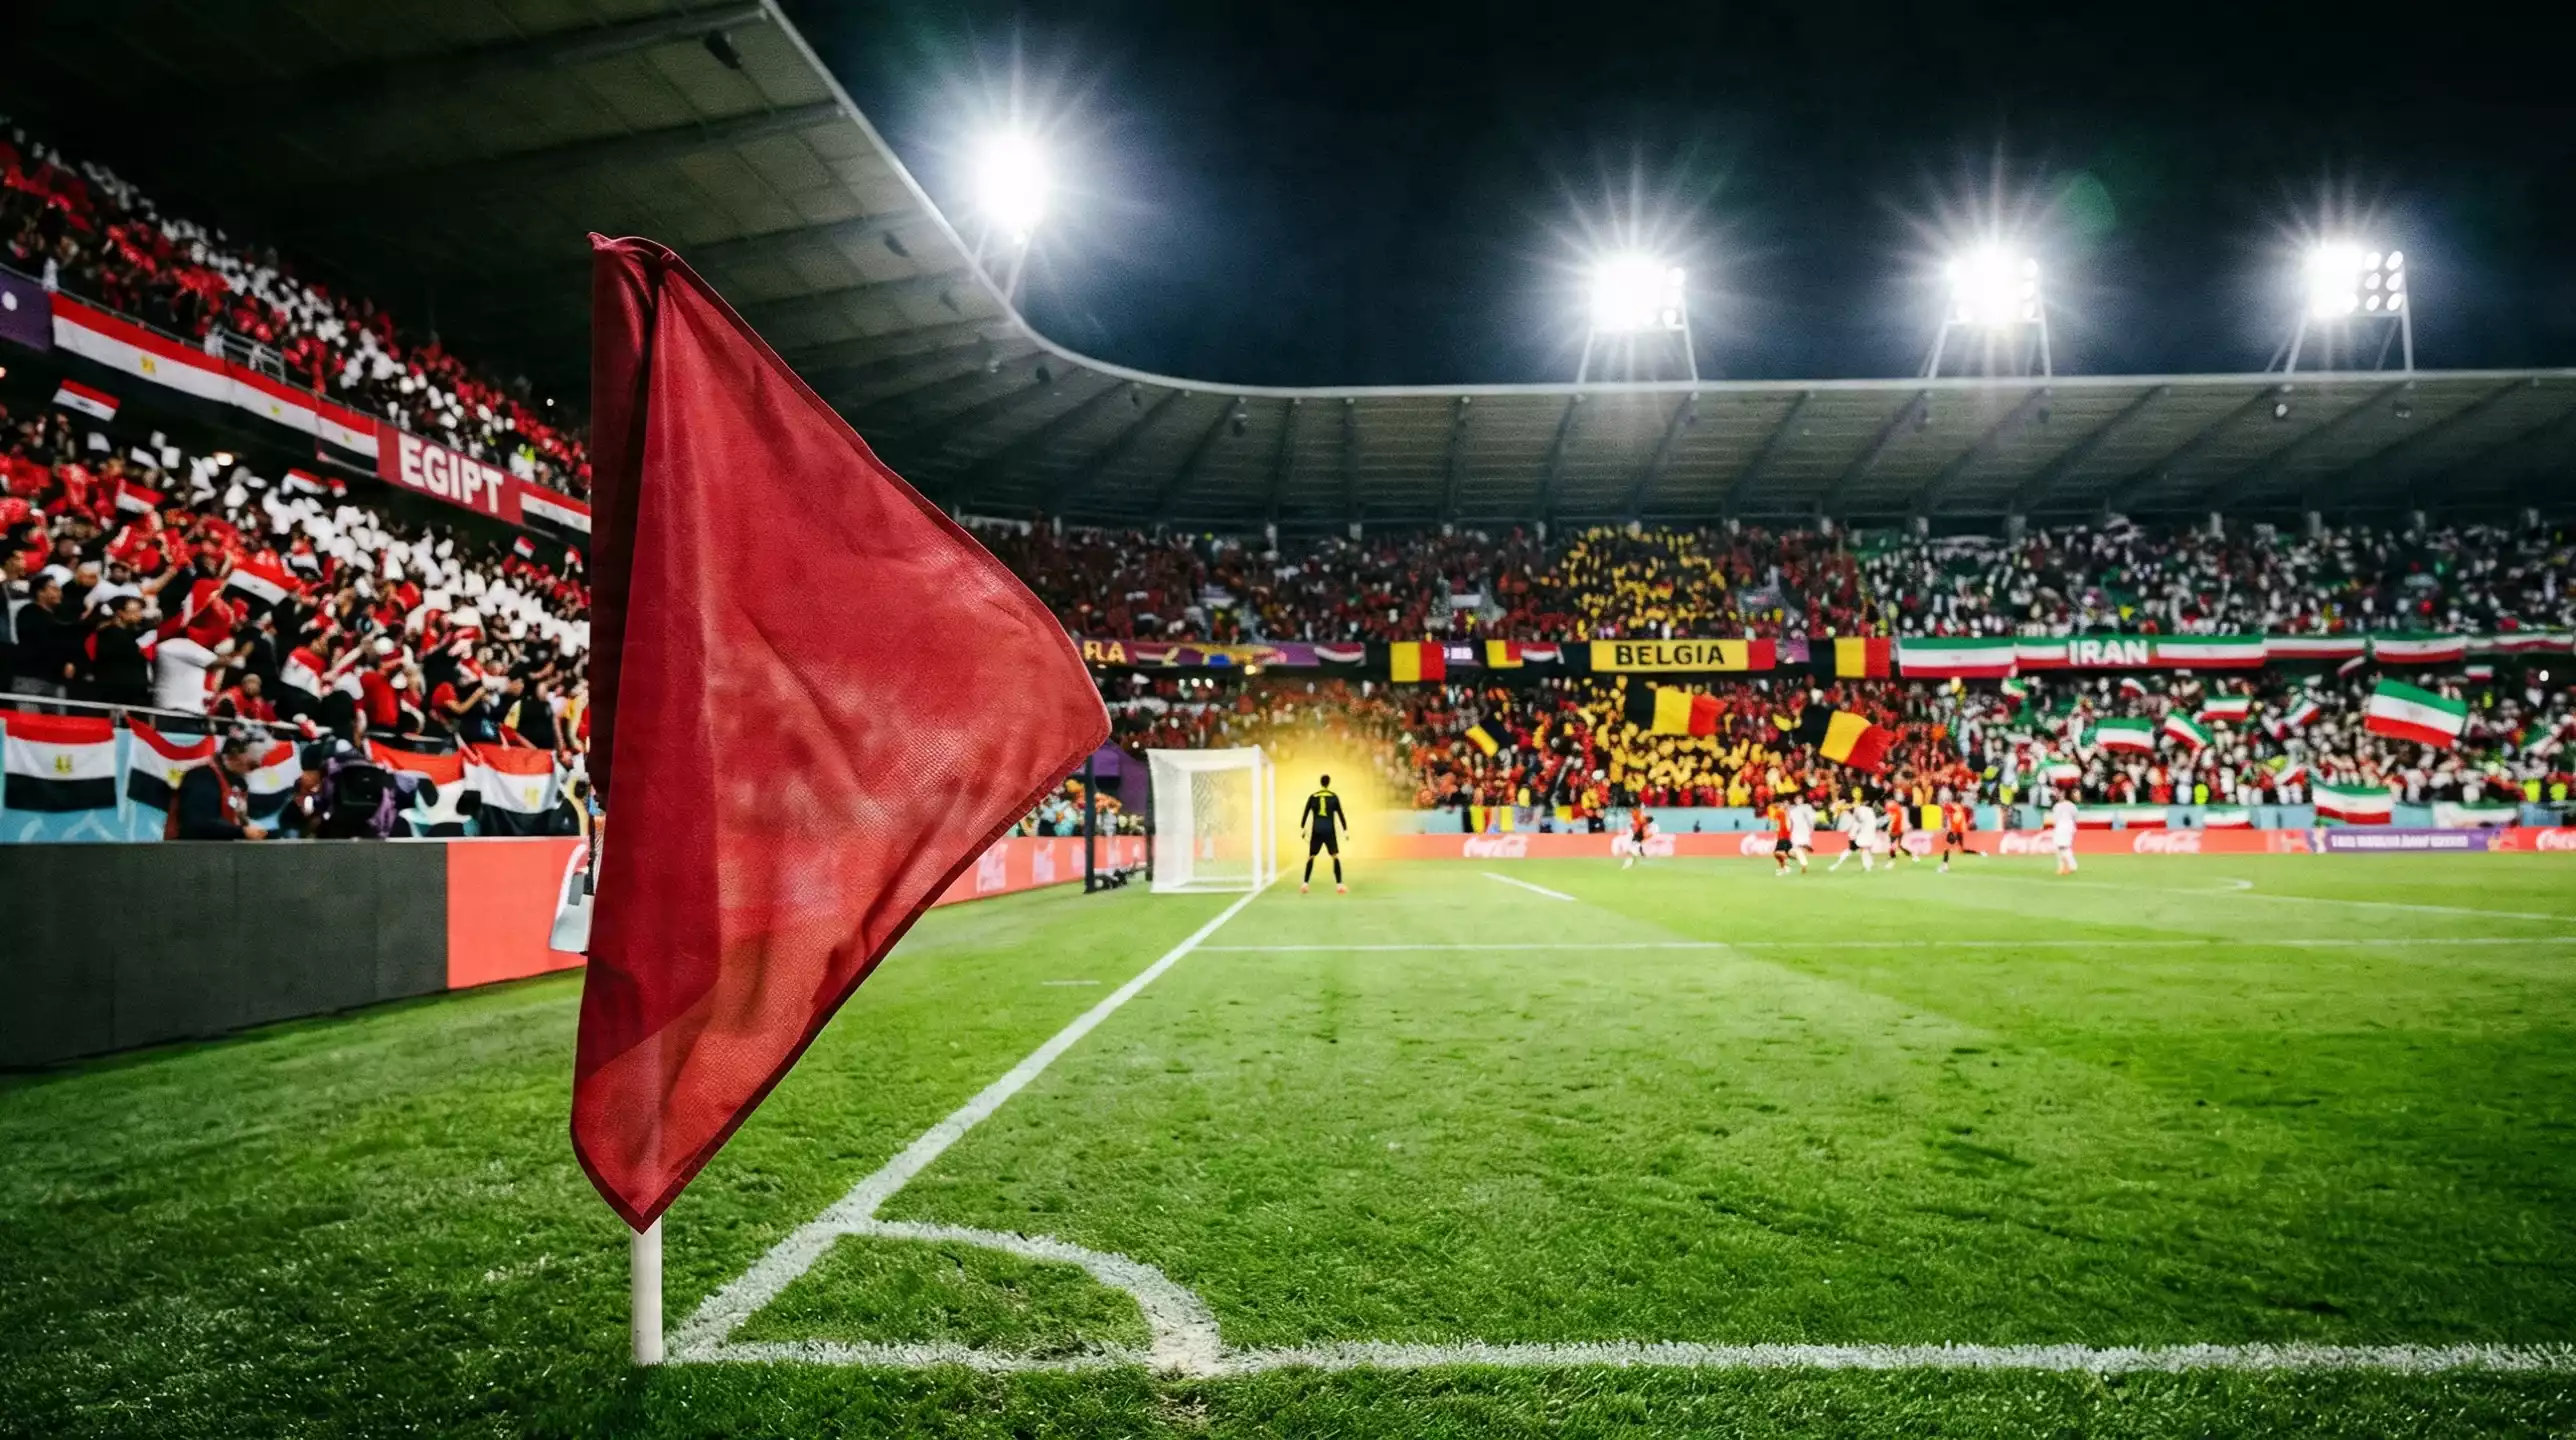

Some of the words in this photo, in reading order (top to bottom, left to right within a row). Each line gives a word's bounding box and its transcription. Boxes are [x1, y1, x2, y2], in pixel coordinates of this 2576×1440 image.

[398, 431, 504, 513] EGIPT
[1615, 645, 1725, 665] BELGIA
[2068, 639, 2149, 665] IRAN
[1319, 796, 1328, 816] 1
